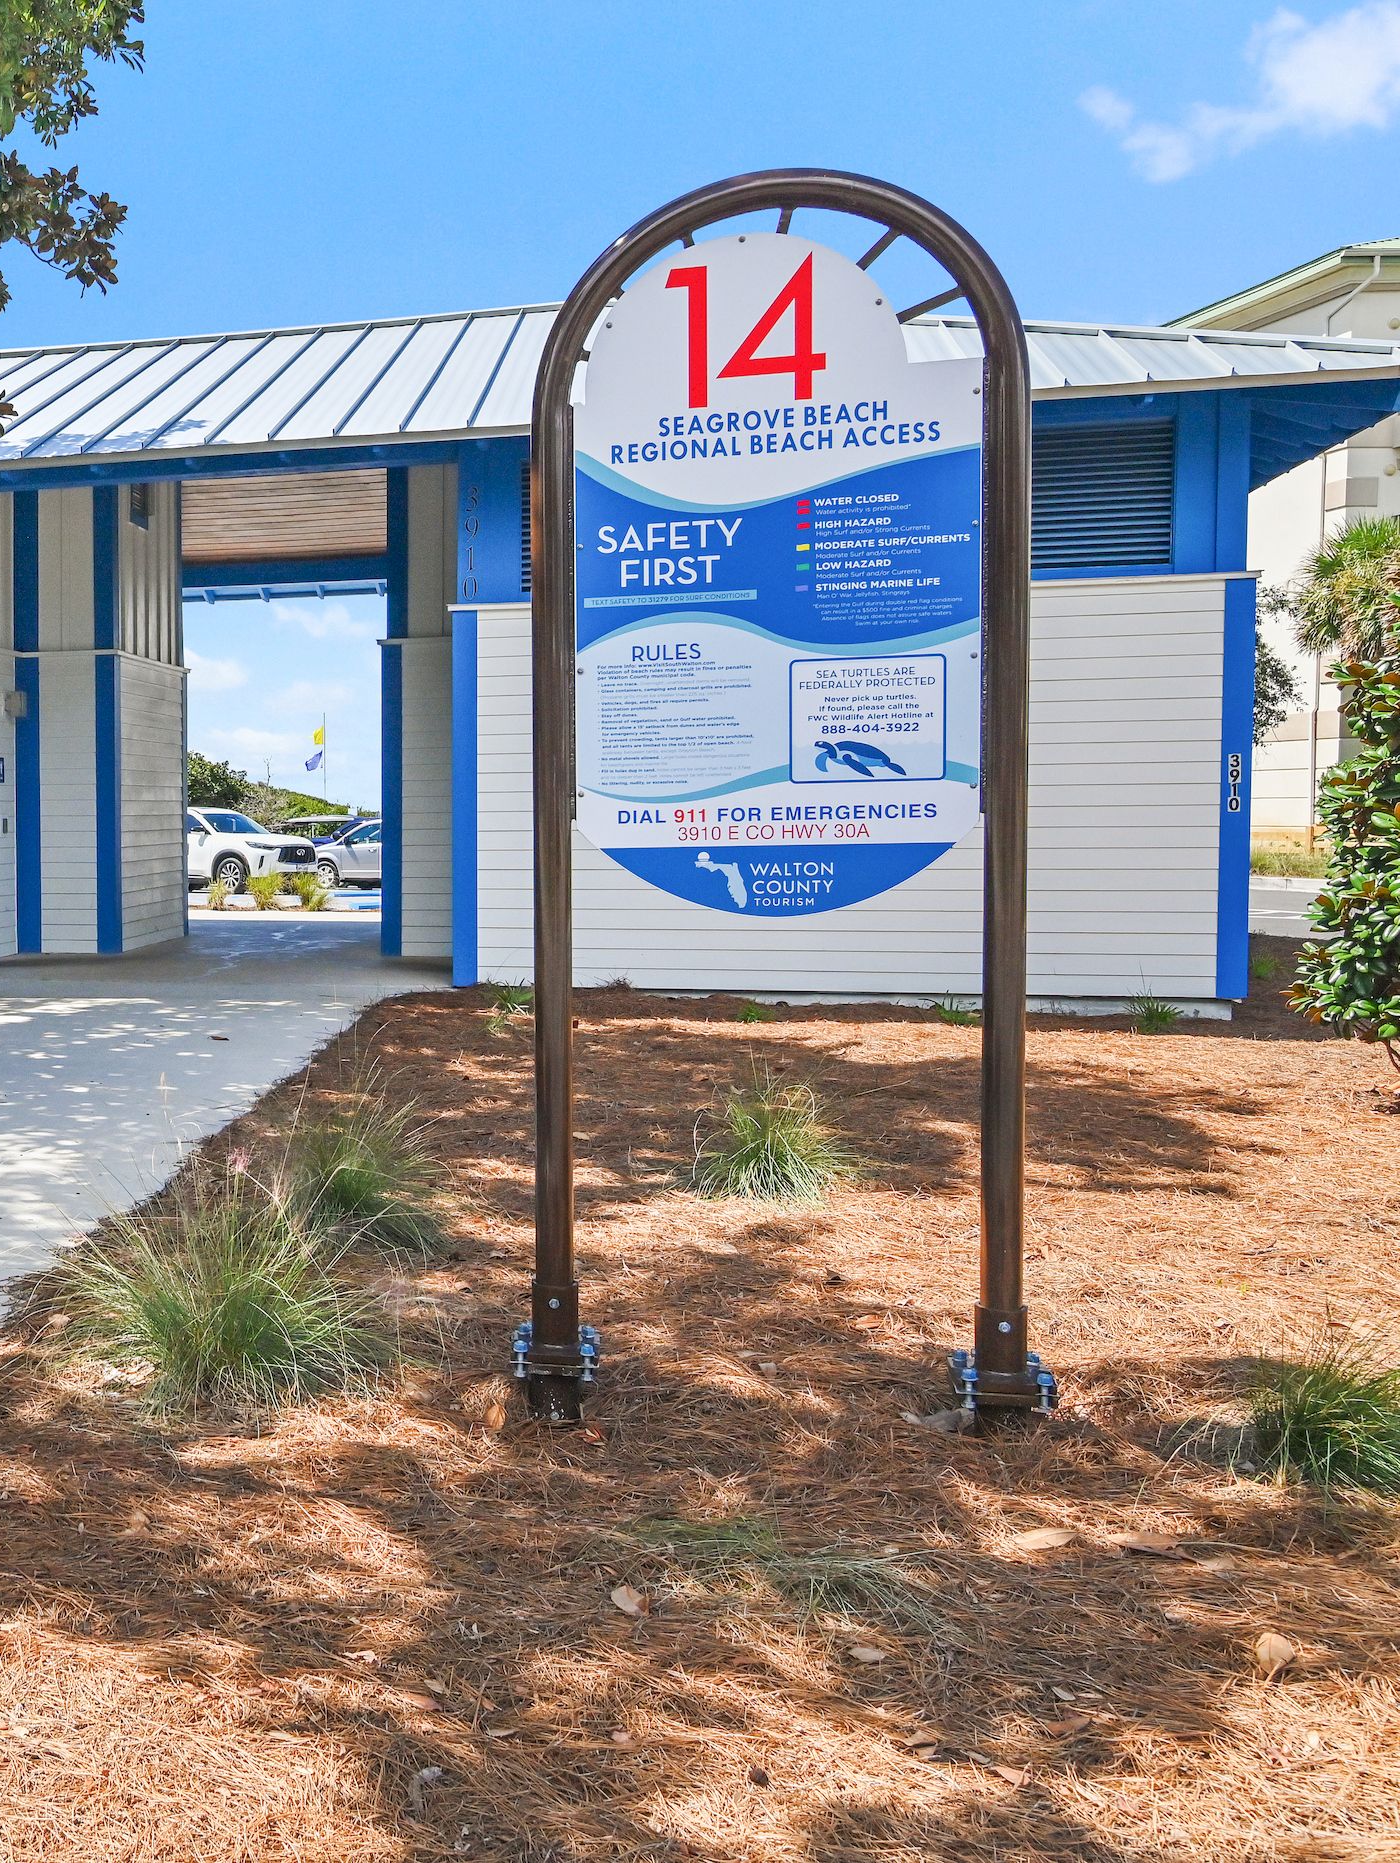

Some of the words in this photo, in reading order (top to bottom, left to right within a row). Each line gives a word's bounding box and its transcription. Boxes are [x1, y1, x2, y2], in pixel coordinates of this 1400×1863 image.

[665, 251, 826, 408] 14
[659, 408, 794, 436] SEAGROVE
[804, 400, 888, 426] BEACH
[611, 436, 741, 464] REGIONAL
[750, 429, 833, 454] BEACH
[842, 422, 940, 448] ACCESS
[814, 496, 852, 507] WATER
[856, 494, 899, 504] CLOSED
[838, 506, 863, 515] activity
[814, 520, 842, 529] HIGH
[844, 517, 891, 527] HAZARD
[597, 518, 742, 554] SAFETY
[816, 529, 832, 538] High
[875, 526, 898, 535] Strong
[900, 524, 930, 532] Currents
[463, 486, 479, 601] 3910
[814, 539, 875, 550] MODERATE
[878, 534, 970, 547] SURF/CURRENTS
[816, 551, 848, 559] Moderate
[816, 561, 842, 570] LOW
[845, 559, 891, 569] HAZARD
[621, 555, 720, 588] FIRST
[816, 571, 849, 579] Moderate
[816, 581, 867, 592] STINGING
[870, 579, 913, 589] MARINE
[916, 578, 940, 587] LIFE
[705, 592, 750, 600] CONDITIONS
[632, 643, 701, 662] RULES
[638, 659, 715, 668] www.VisitSouthWalton.com
[726, 664, 752, 672] penalties
[651, 672, 678, 680] municipal
[816, 670, 837, 679] SEA
[841, 667, 889, 678] TURTLES
[894, 666, 915, 675] ARE
[799, 680, 862, 690] FEDERALLY
[866, 677, 935, 687] PROTECTED
[857, 704, 885, 712] please
[822, 722, 919, 734] 888-404-3922
[1229, 754, 1240, 811] 3910
[617, 810, 665, 825] DIAL
[674, 809, 707, 823] 911
[717, 807, 762, 822] FOR
[771, 803, 937, 821] EMERGENCIES
[678, 826, 721, 841] 3910
[728, 826, 738, 840] E
[746, 825, 774, 840] CO
[782, 824, 827, 839] HWY
[834, 823, 870, 839] 30A
[750, 862, 833, 876] WALTON
[752, 880, 833, 895] COUNTY
[754, 898, 814, 906] TOURISM
